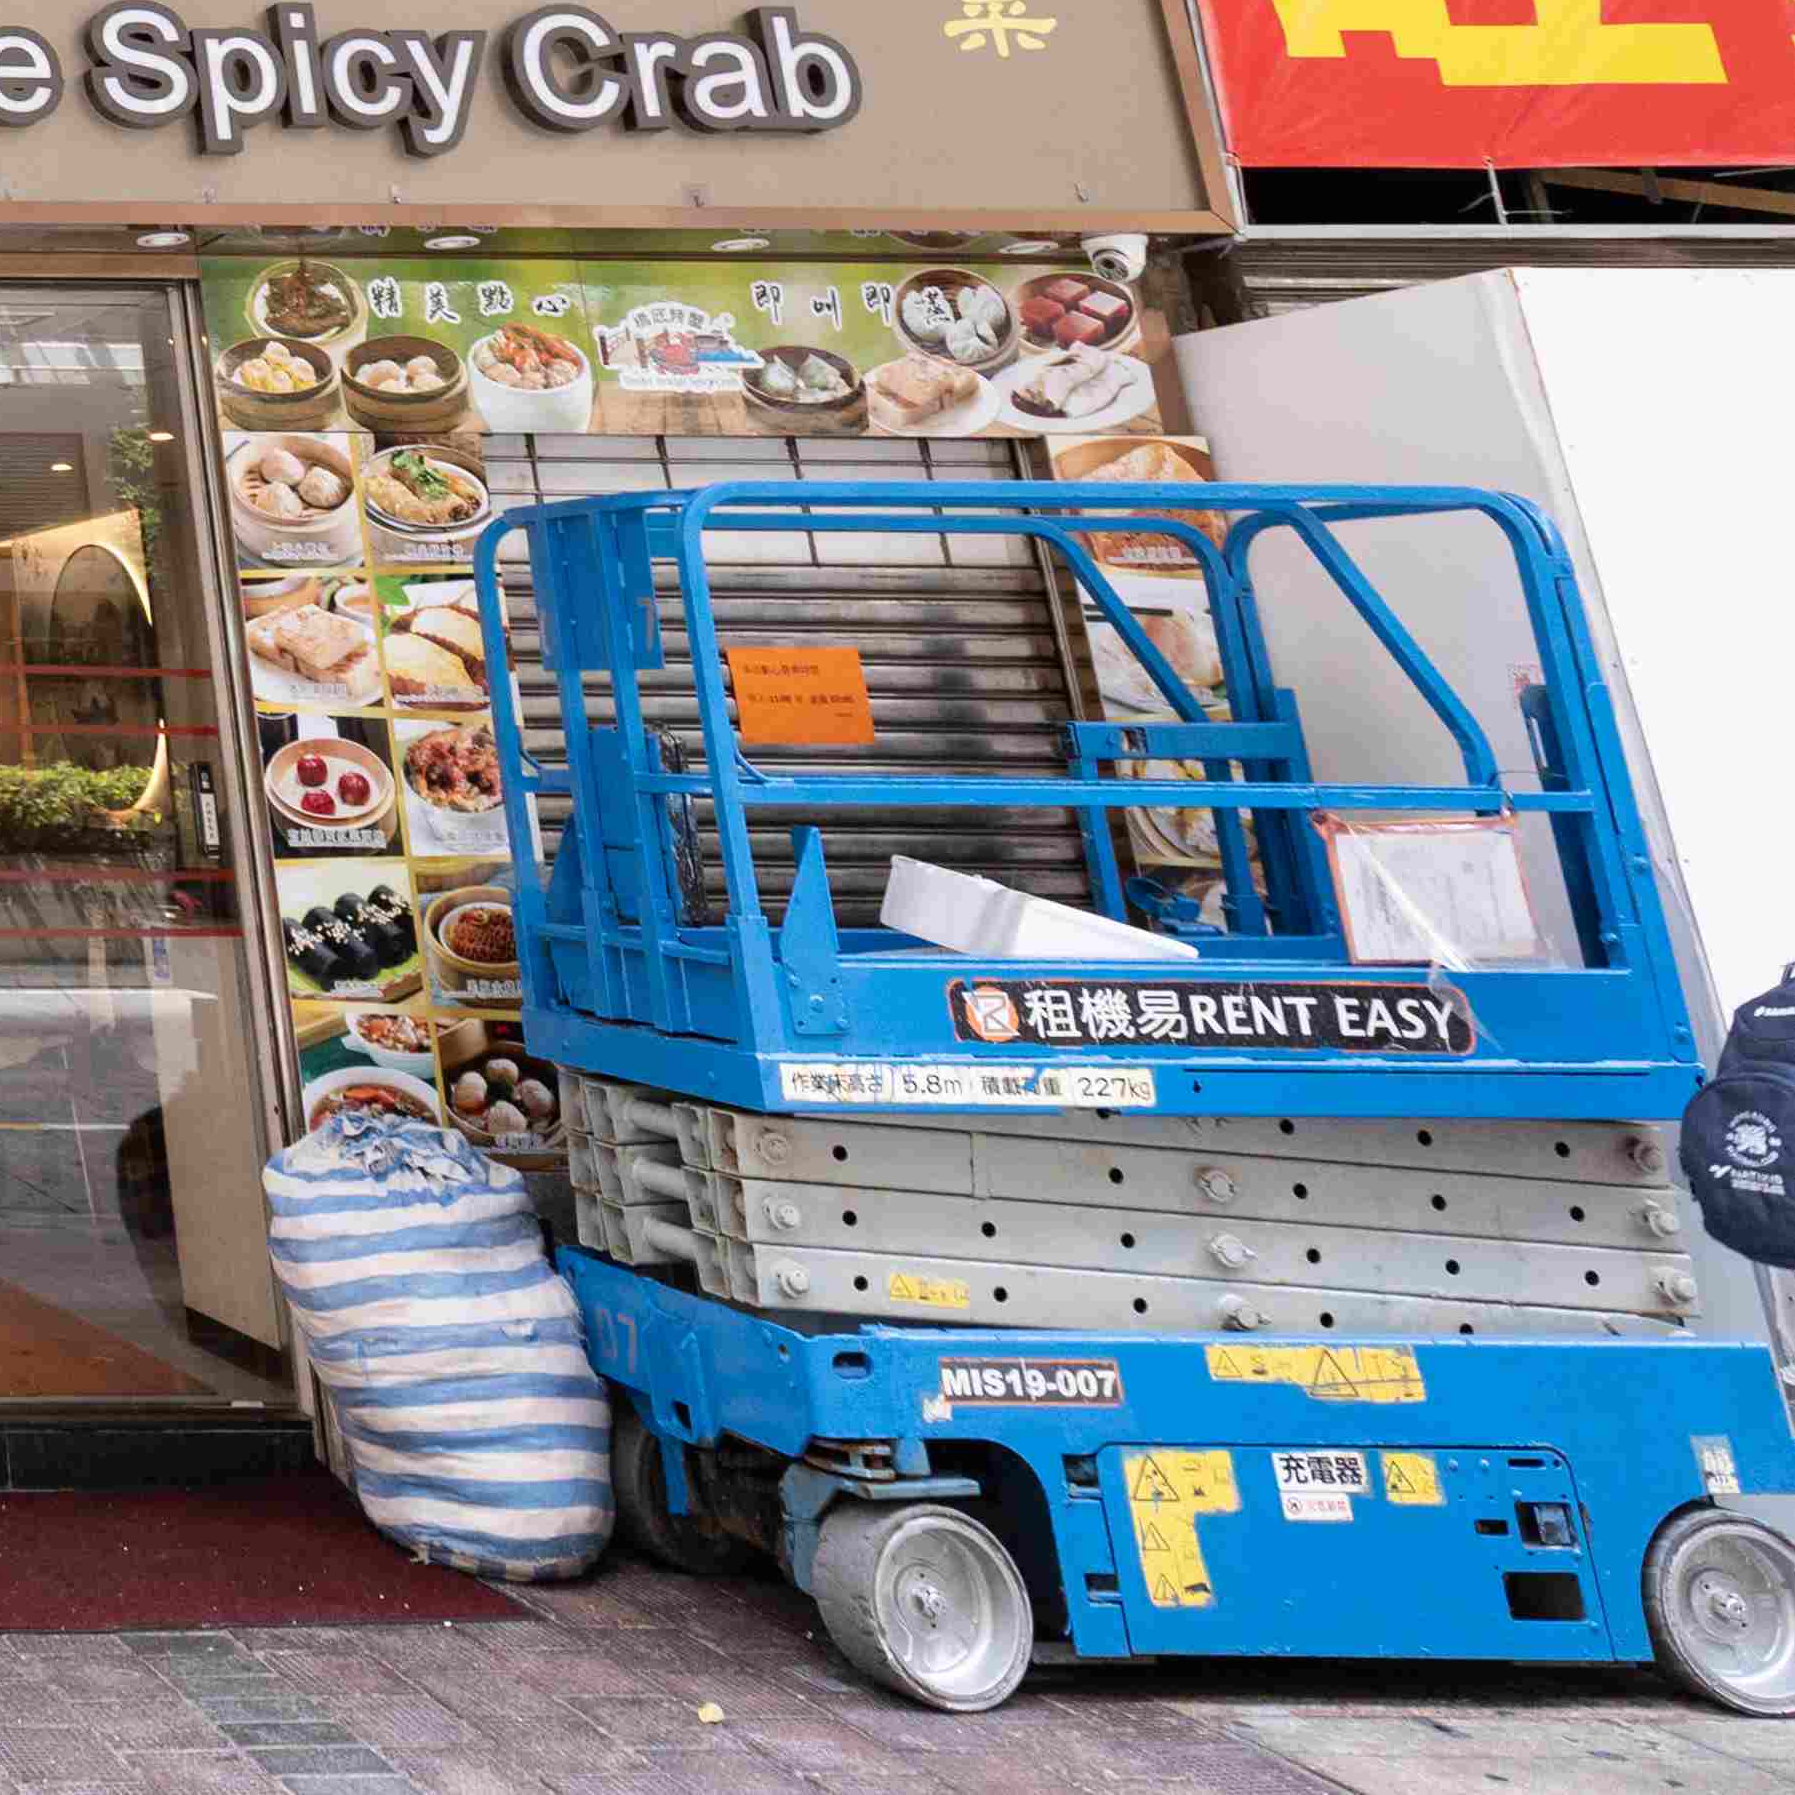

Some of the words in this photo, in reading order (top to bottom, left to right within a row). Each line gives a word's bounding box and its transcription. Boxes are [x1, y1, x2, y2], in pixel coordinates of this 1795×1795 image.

[94, 5, 483, 154] Spicy
[512, 5, 860, 131] Crab
[367, 275, 574, 326] 精美點心
[1026, 989, 1186, 1039] 租機易
[1190, 995, 1316, 1037] RENT
[1334, 995, 1458, 1040] EASY
[901, 1072, 963, 1095] 5.8m
[1076, 1075, 1152, 1101] 227kg
[941, 1366, 1117, 1402] MIS19-007
[1278, 1454, 1364, 1486] 充電器
